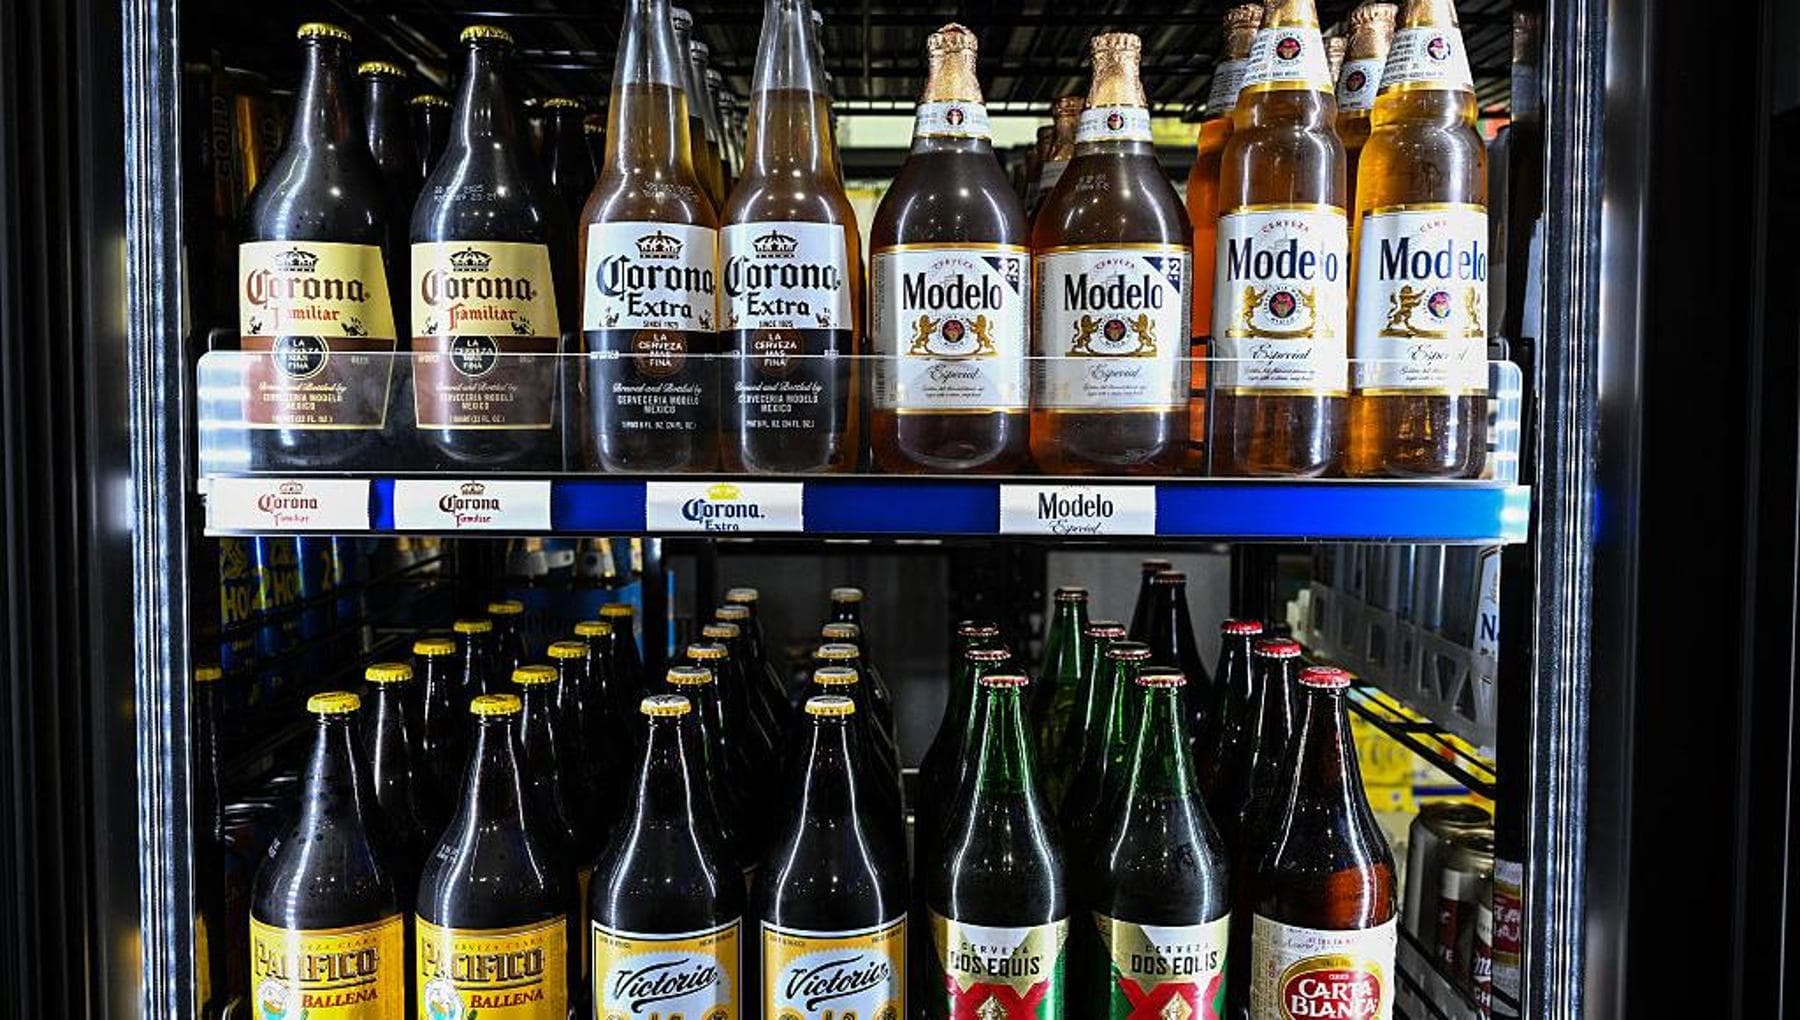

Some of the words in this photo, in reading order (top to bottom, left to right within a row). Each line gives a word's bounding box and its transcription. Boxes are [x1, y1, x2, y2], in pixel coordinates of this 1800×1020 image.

[1226, 237, 1338, 282] Modeo
[1379, 236, 1487, 282] Modelo
[421, 268, 533, 306] Corona
[596, 253, 715, 302] Corona
[724, 255, 839, 300] Corona
[246, 268, 367, 310] Corona
[902, 271, 1003, 311] Modelo
[1064, 272, 1163, 311] Modelo
[626, 292, 694, 319] Extra
[746, 291, 811, 316] Extra
[447, 302, 518, 331] Familiar
[292, 339, 305, 347] LA
[466, 339, 479, 347] LA
[638, 341, 683, 351] CERVEZA
[653, 333, 668, 342] LA
[754, 341, 798, 351] CERVEZA
[768, 333, 782, 342] LA
[649, 358, 673, 367] FINA
[1248, 343, 1313, 366] Especial
[928, 363, 981, 384] Especial
[1089, 362, 1140, 383] Especial
[617, 394, 667, 406] CERVECERIA
[258, 493, 318, 514] Corona
[439, 493, 501, 514] Corona
[1038, 491, 1114, 520] Modelo
[705, 519, 740, 531] Extra
[454, 943, 499, 951] ERVEZA
[961, 942, 1029, 955] CERVEZA
[987, 956, 1041, 977] EQUIS
[1131, 954, 1167, 975] DOS
[614, 959, 719, 1002] Victoria
[786, 955, 889, 1001] Victoria
[302, 987, 379, 1009] BALLENA
[469, 988, 545, 1009] BALLENA
[1298, 978, 1373, 1001] CARTA
